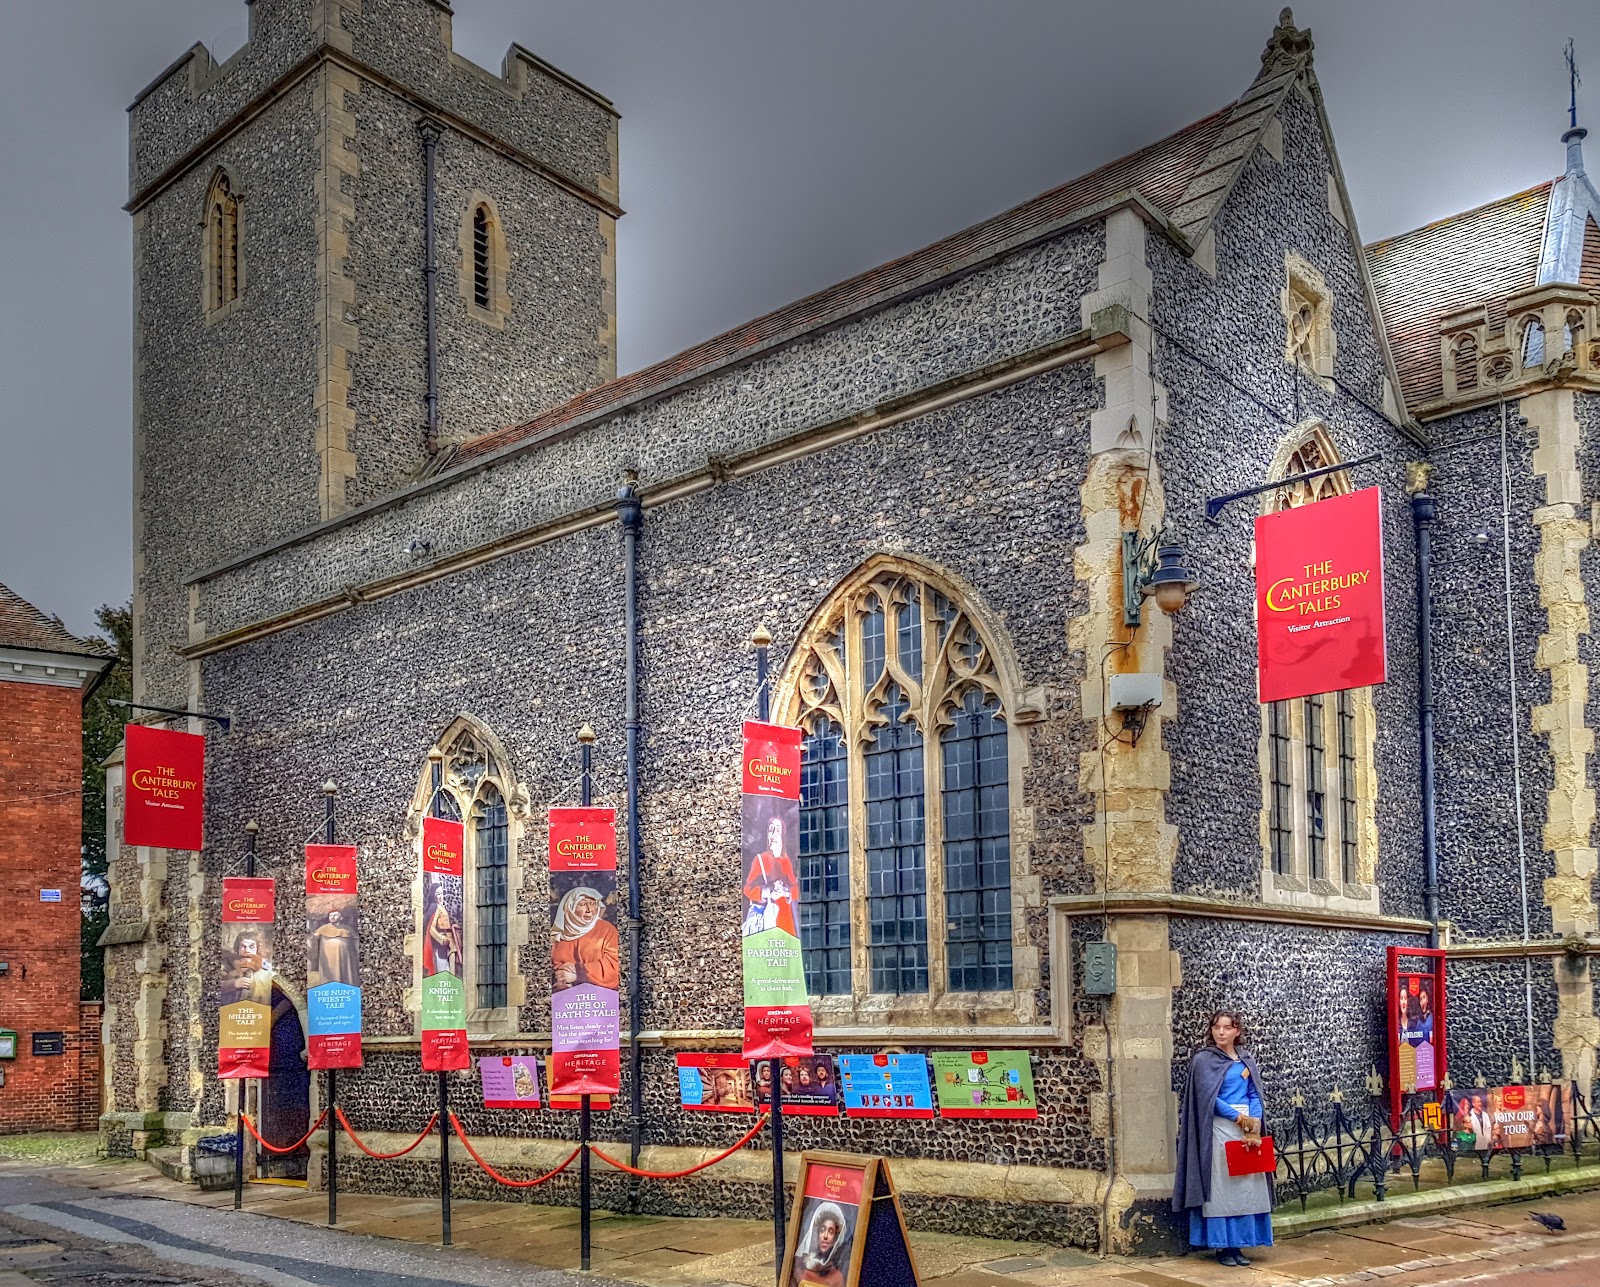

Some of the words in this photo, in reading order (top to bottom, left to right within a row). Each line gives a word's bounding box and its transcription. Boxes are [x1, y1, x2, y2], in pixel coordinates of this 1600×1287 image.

[1304, 560, 1333, 578] THE
[1266, 570, 1370, 612] CANTERBURY
[1298, 595, 1341, 616] TALES
[1287, 623, 1311, 634] Visitor
[1313, 616, 1351, 628] Attraction
[766, 756, 778, 764] THE
[157, 766, 175, 776] THE
[749, 759, 792, 777] CANTERBURY
[132, 770, 197, 790] CANTERBURY
[763, 775, 780, 784] TALES
[152, 788, 179, 799] TALES
[428, 845, 457, 859] CANTERBURY
[557, 839, 607, 855] CANTERBURY
[312, 870, 350, 882] CANTERBURY
[229, 900, 267, 911] CANTERBURY
[768, 940, 785, 948] THE
[748, 949, 798, 958] PARDONER'S
[555, 1011, 590, 1019] BATH'S
[1494, 1112, 1516, 1124] JOIN
[1517, 1111, 1535, 1121] OUR
[1503, 1124, 1528, 1135] TOUR
